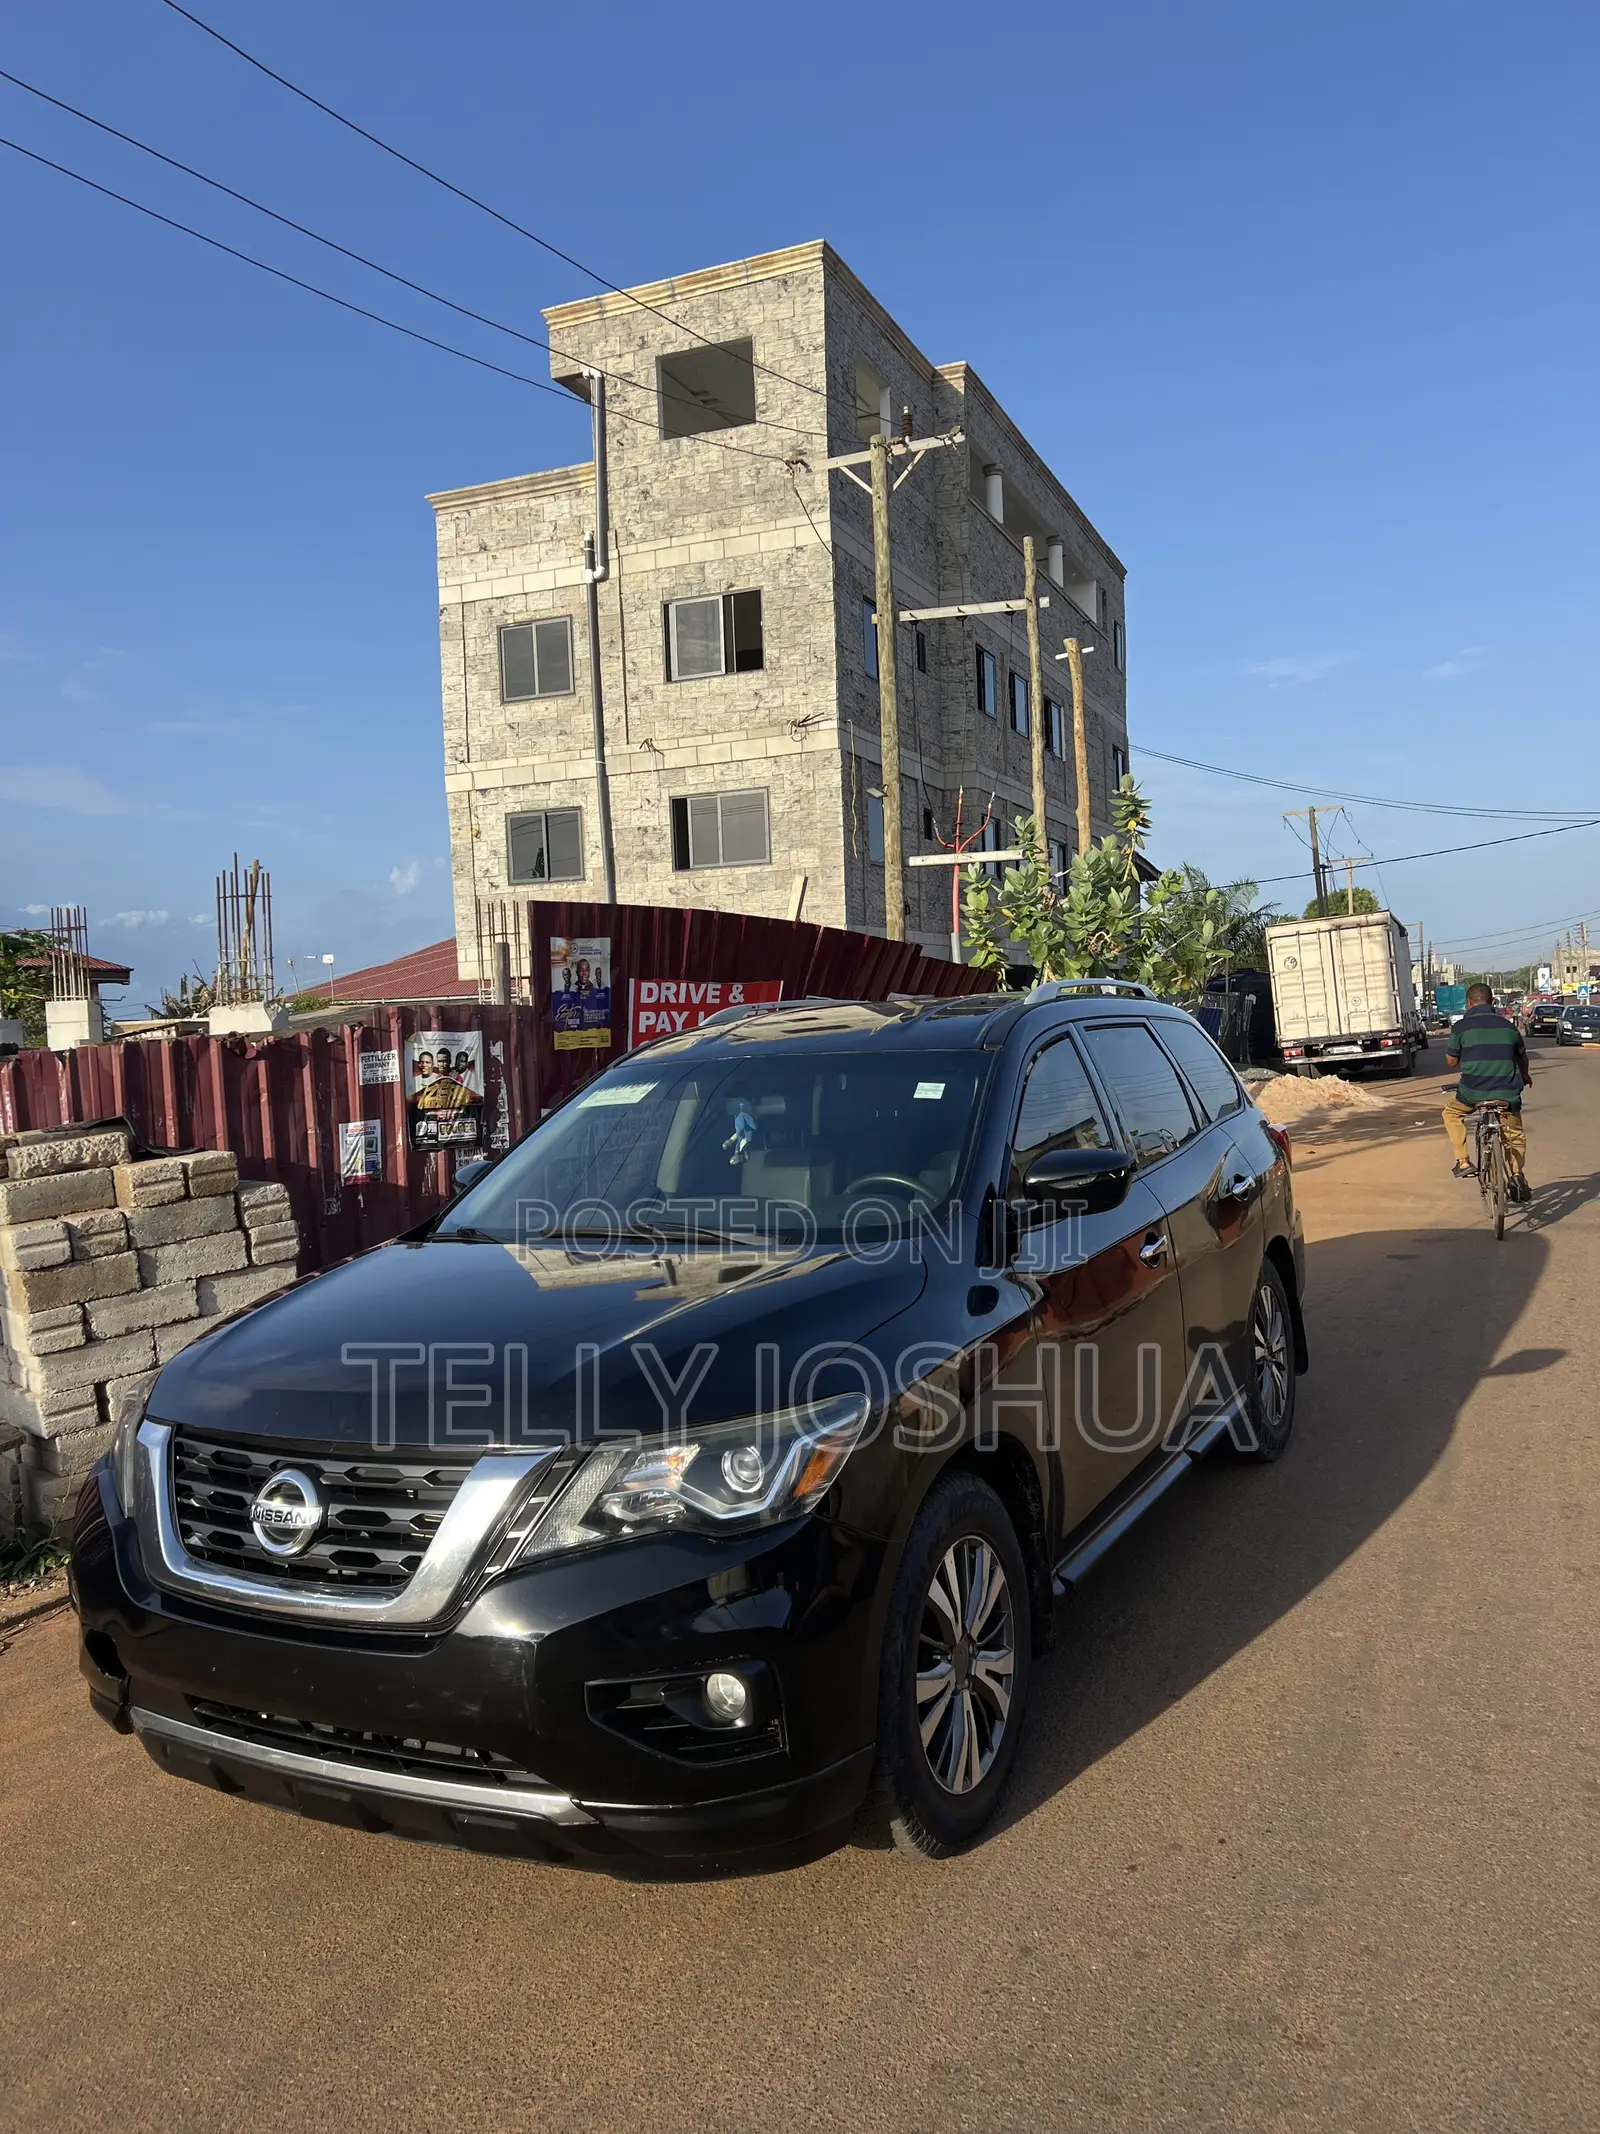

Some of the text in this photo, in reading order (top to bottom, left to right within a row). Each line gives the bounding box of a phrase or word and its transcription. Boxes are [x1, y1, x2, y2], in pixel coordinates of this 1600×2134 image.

[640, 982, 744, 1004] DRIVE &
[638, 1011, 690, 1032] PAY
[361, 1053, 397, 1063] FERTILIZER
[363, 1062, 390, 1070] COMPANY
[250, 1504, 312, 1525] NISSAN
